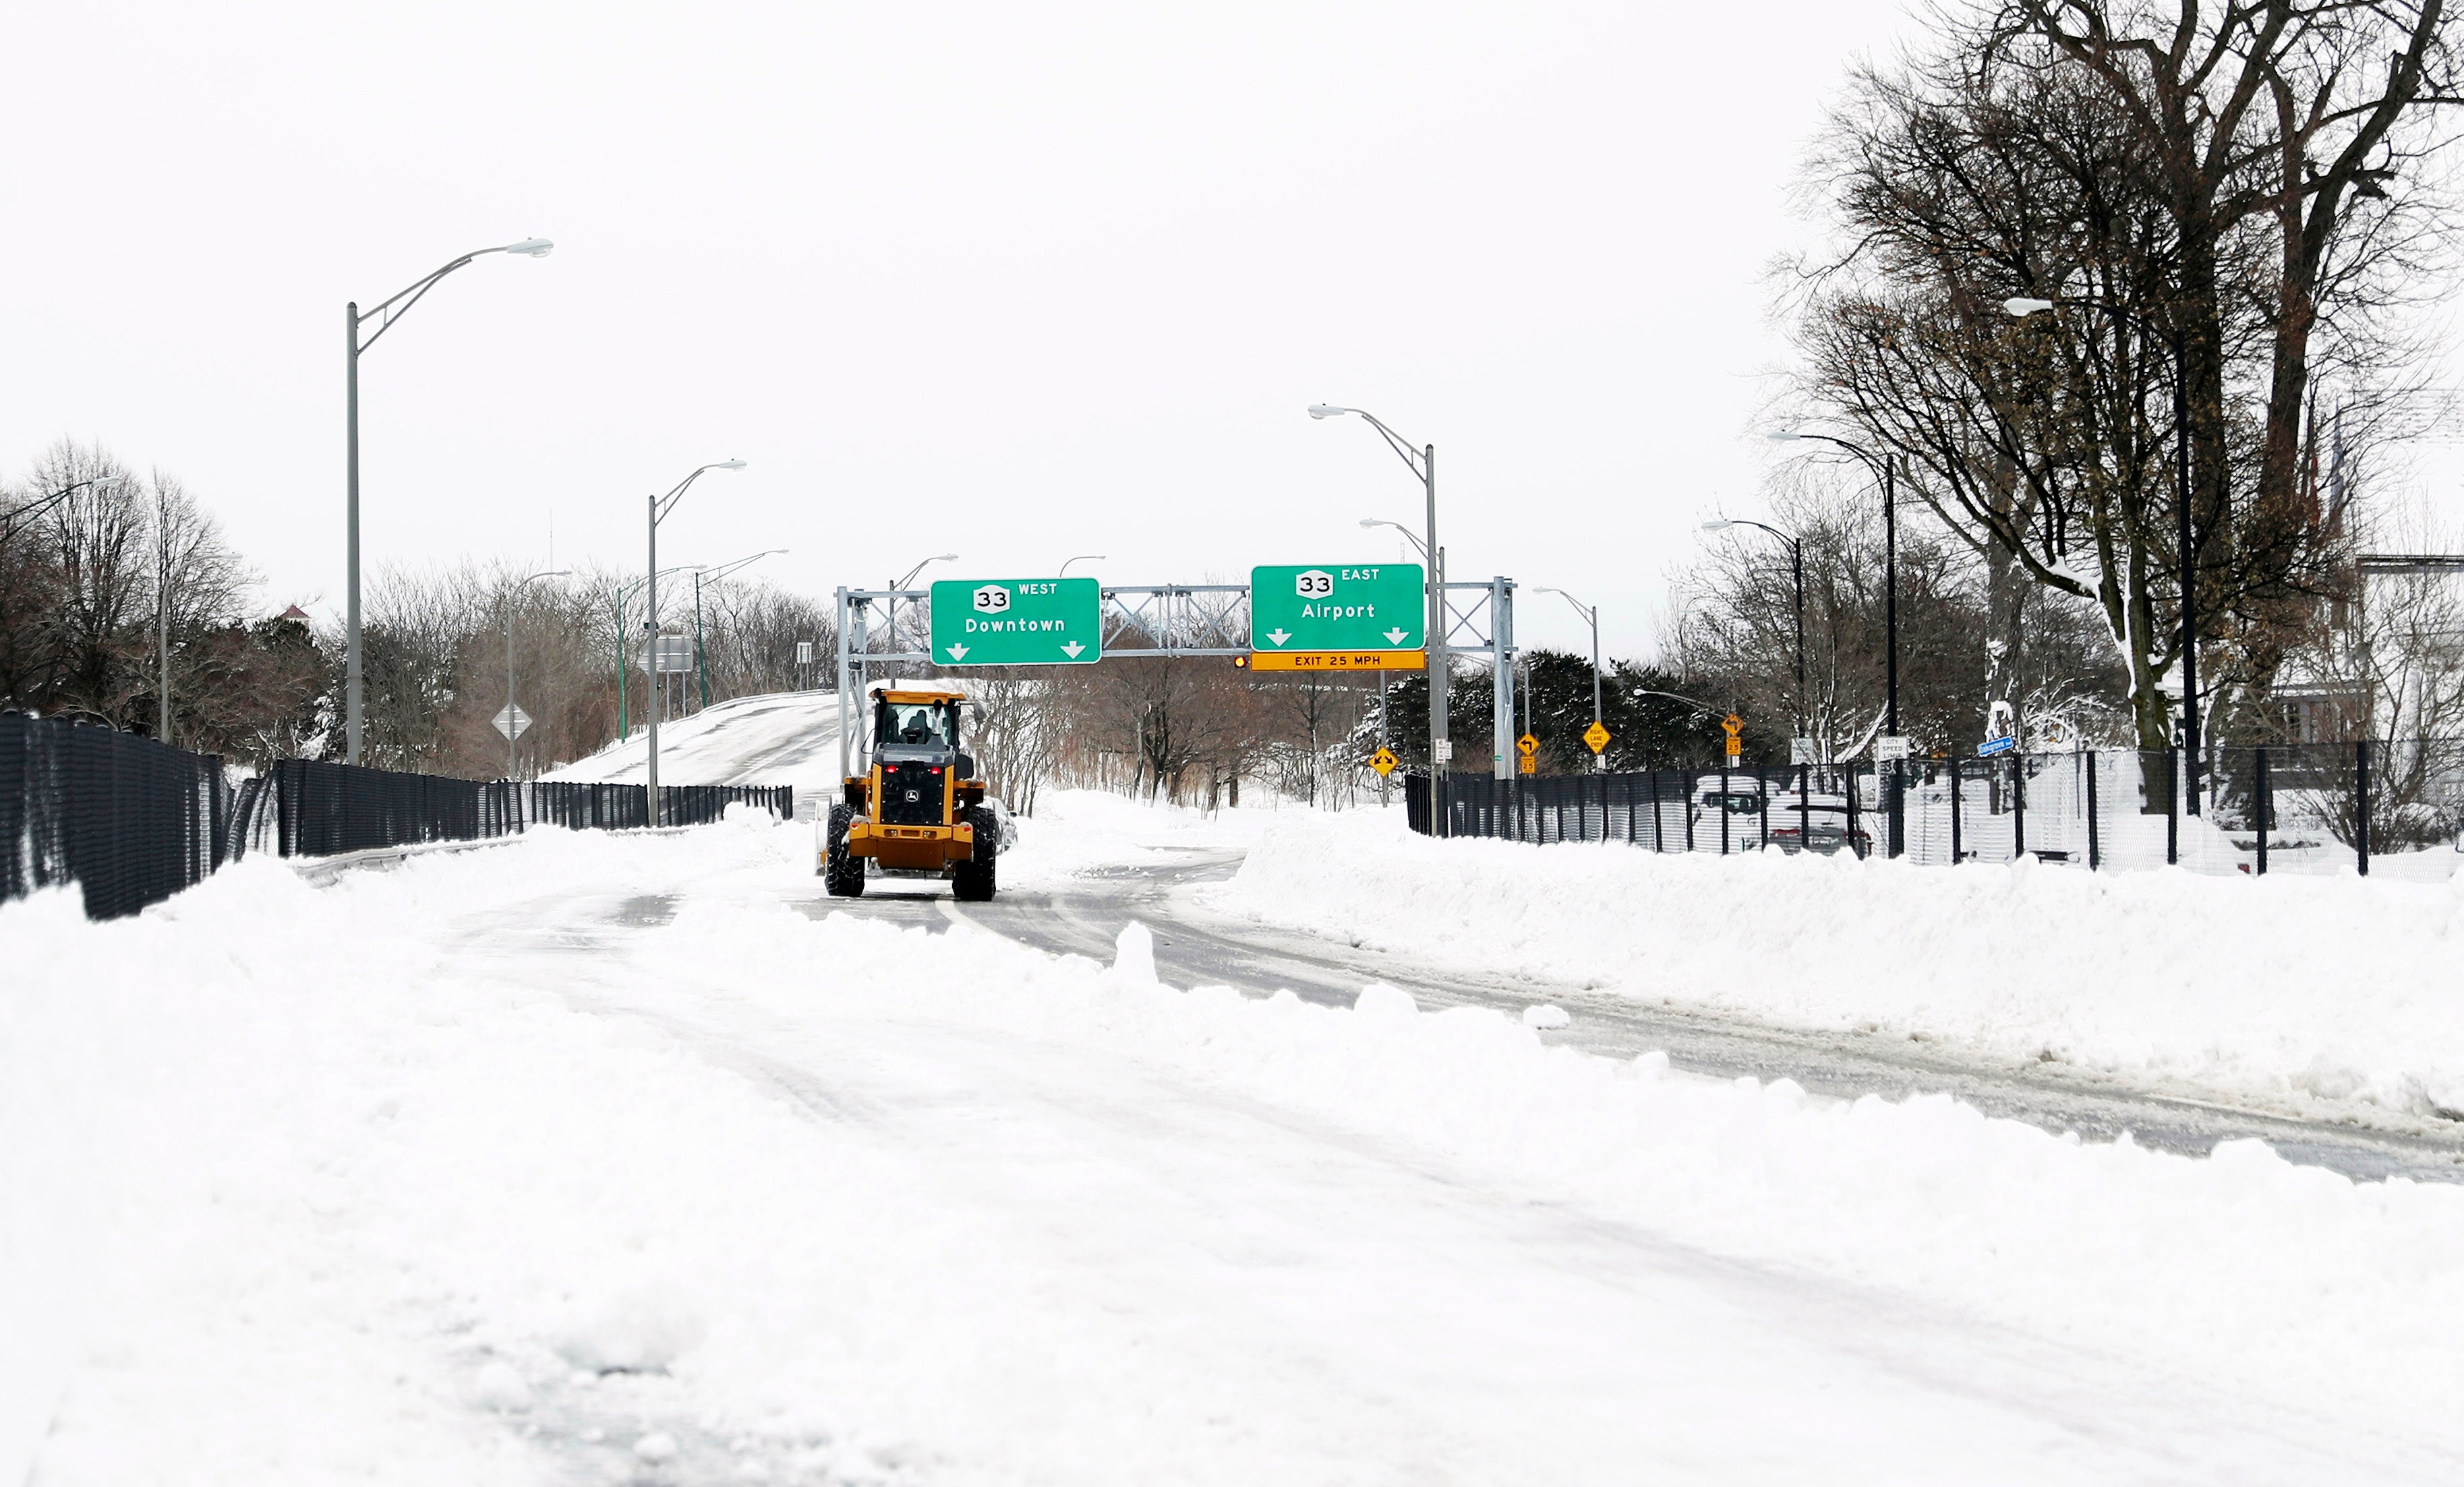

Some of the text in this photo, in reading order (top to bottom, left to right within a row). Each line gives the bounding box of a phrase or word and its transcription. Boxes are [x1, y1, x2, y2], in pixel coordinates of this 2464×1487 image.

[1299, 568, 1380, 592] 33 EAST
[978, 583, 1057, 607] 33 WEST
[1301, 603, 1375, 621] Airport
[965, 618, 1065, 633] Downtown
[1295, 655, 1380, 666] EXIT 25 MPH
